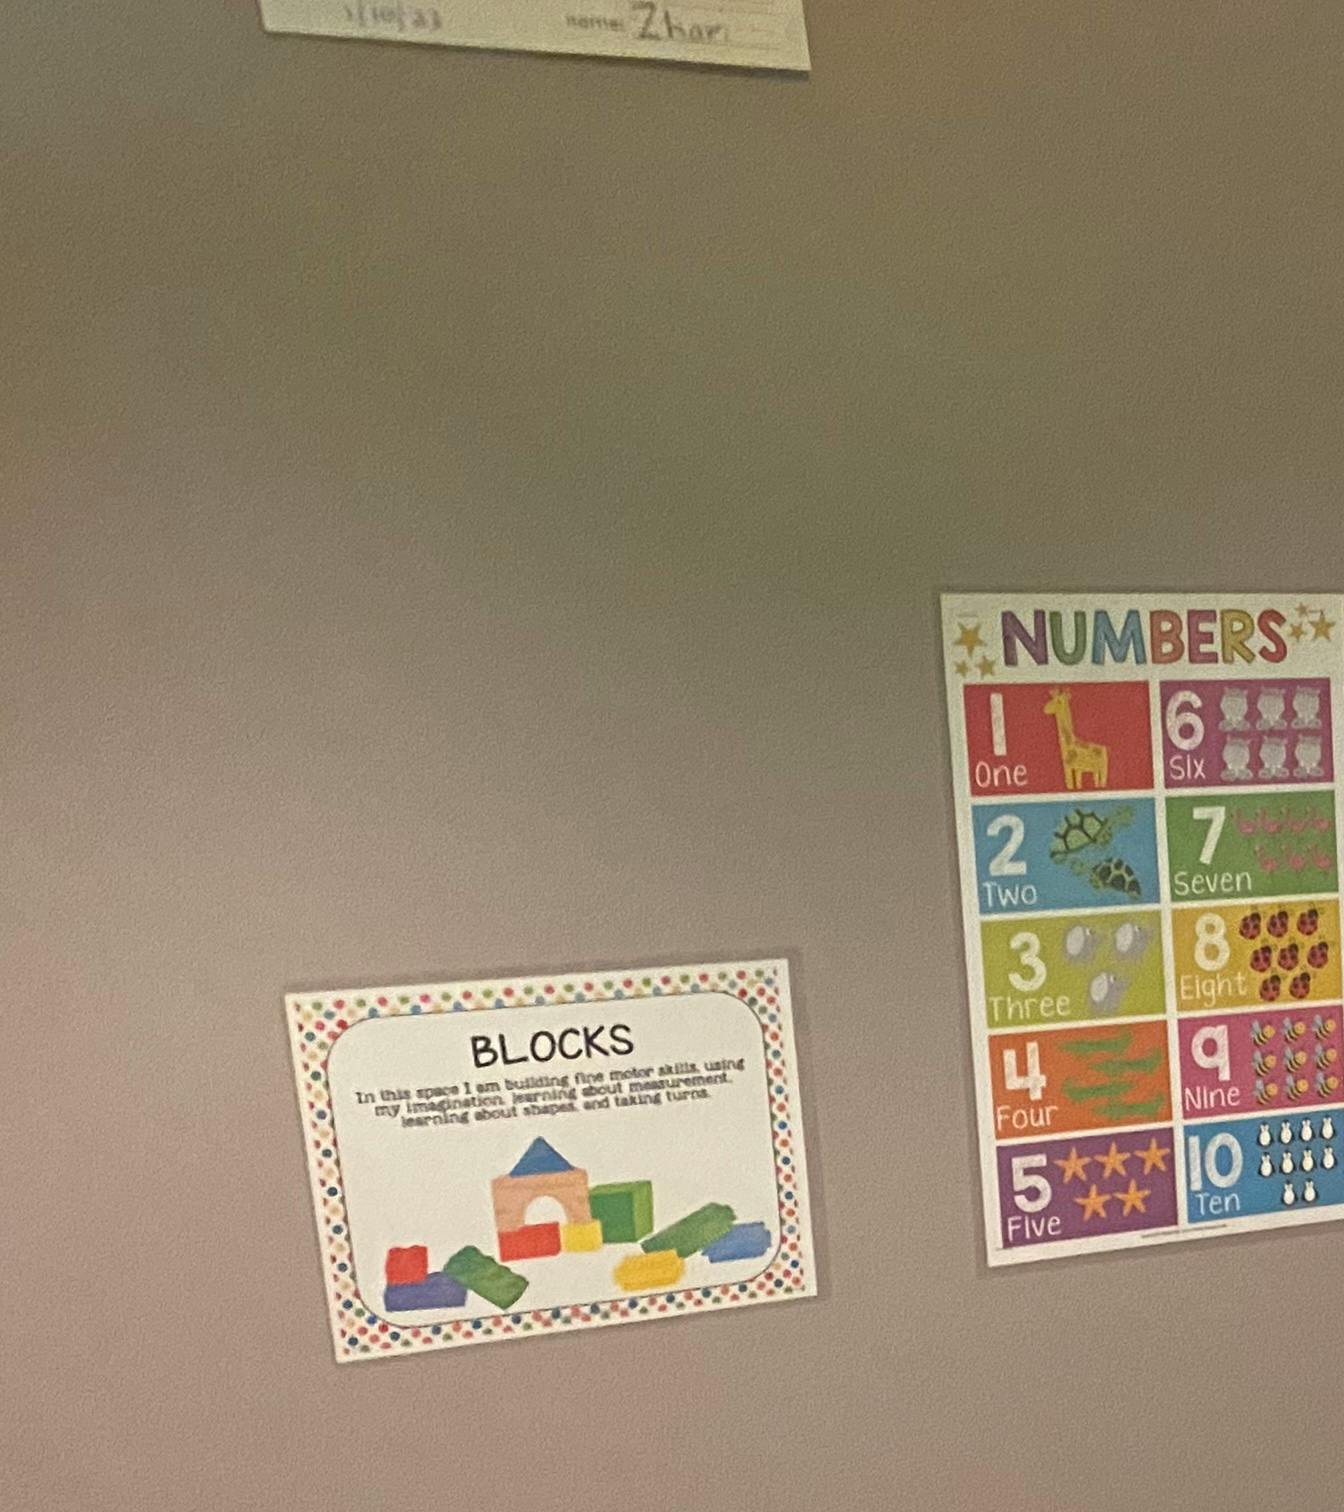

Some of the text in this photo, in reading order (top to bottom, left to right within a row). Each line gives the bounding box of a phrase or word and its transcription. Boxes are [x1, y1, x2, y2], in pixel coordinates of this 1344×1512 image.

[1001, 609, 1288, 667] NUMBERS
[1166, 690, 1205, 751] 6
[975, 760, 1028, 787] One
[985, 814, 1027, 877] 2
[1193, 806, 1226, 865] 7
[982, 882, 1038, 907] Two
[1173, 869, 1253, 897] Seven
[1007, 931, 1047, 992] 3
[1193, 912, 1231, 971] 8
[989, 994, 1072, 1024] Three
[1180, 971, 1248, 1008] Eight
[470, 1024, 634, 1068] BLOCKS
[1191, 1025, 1231, 1082] 9
[355, 1091, 376, 1105] In
[379, 1088, 411, 1102] this
[416, 1085, 459, 1101] space
[463, 1081, 471, 1095] I
[476, 1081, 500, 1094] am
[504, 1075, 569, 1091] building
[574, 1071, 604, 1085] fine
[609, 1066, 654, 1082] motor
[703, 1057, 744, 1072] using
[1002, 1041, 1047, 1101] 4
[374, 1104, 400, 1118] my
[512, 1087, 577, 1105] learning
[581, 1081, 622, 1097] about
[401, 1110, 470, 1128] learning
[474, 1105, 517, 1121] about
[583, 1095, 610, 1111] and
[614, 1091, 662, 1108] taking
[996, 1104, 1058, 1131] Four
[1010, 1153, 1052, 1214] 5
[1188, 1132, 1243, 1191] 10
[1194, 1192, 1241, 1216] Ten
